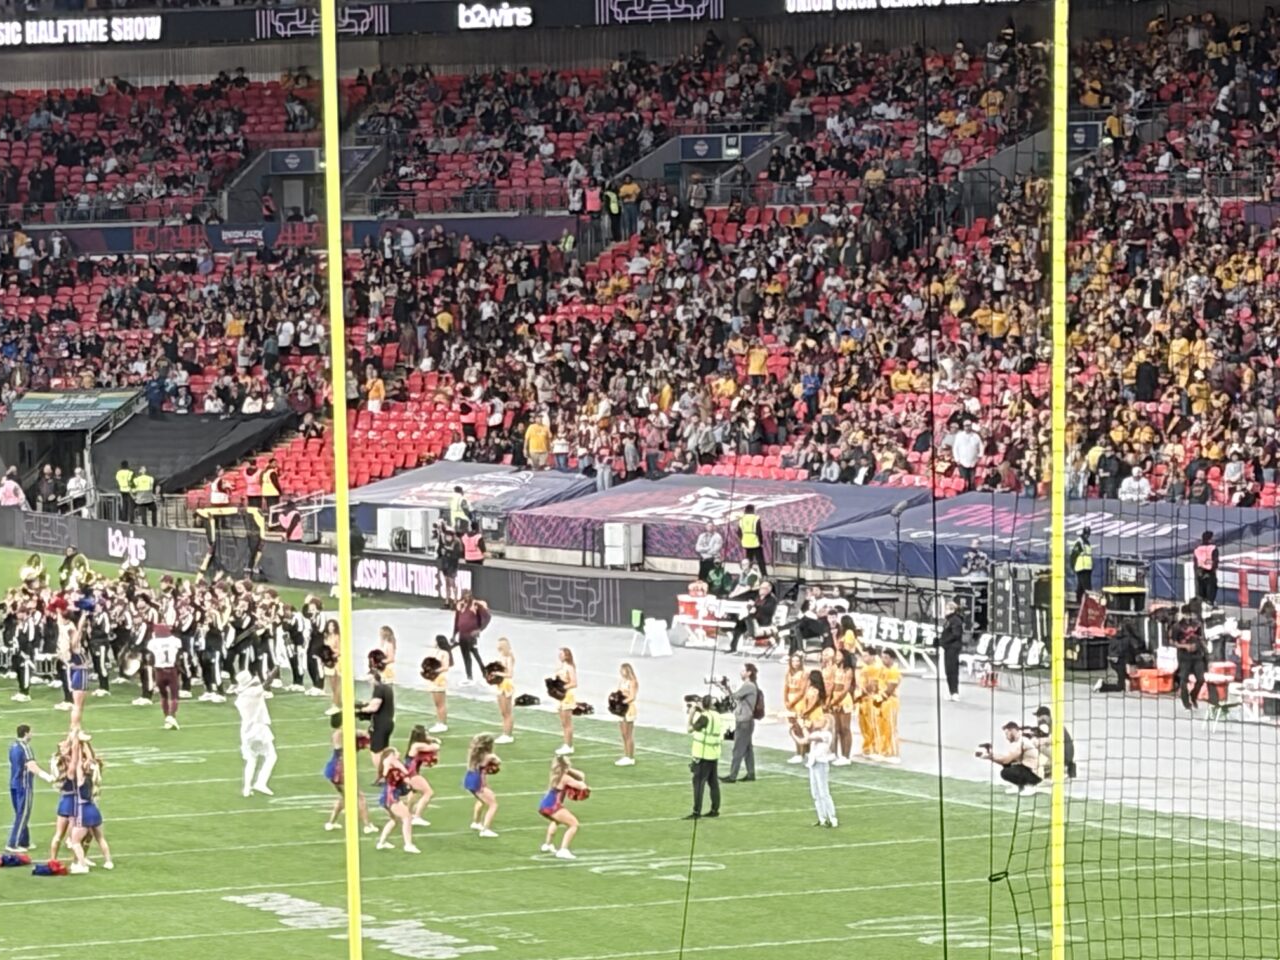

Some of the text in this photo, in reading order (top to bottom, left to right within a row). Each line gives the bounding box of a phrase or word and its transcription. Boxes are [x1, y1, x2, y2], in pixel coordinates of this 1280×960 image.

[458, 2, 533, 29] b2wins
[25, 18, 108, 44] HALFTIME
[111, 16, 162, 42] SHOW
[318, 552, 338, 584] JAC
[388, 561, 440, 598] HALFTIME
